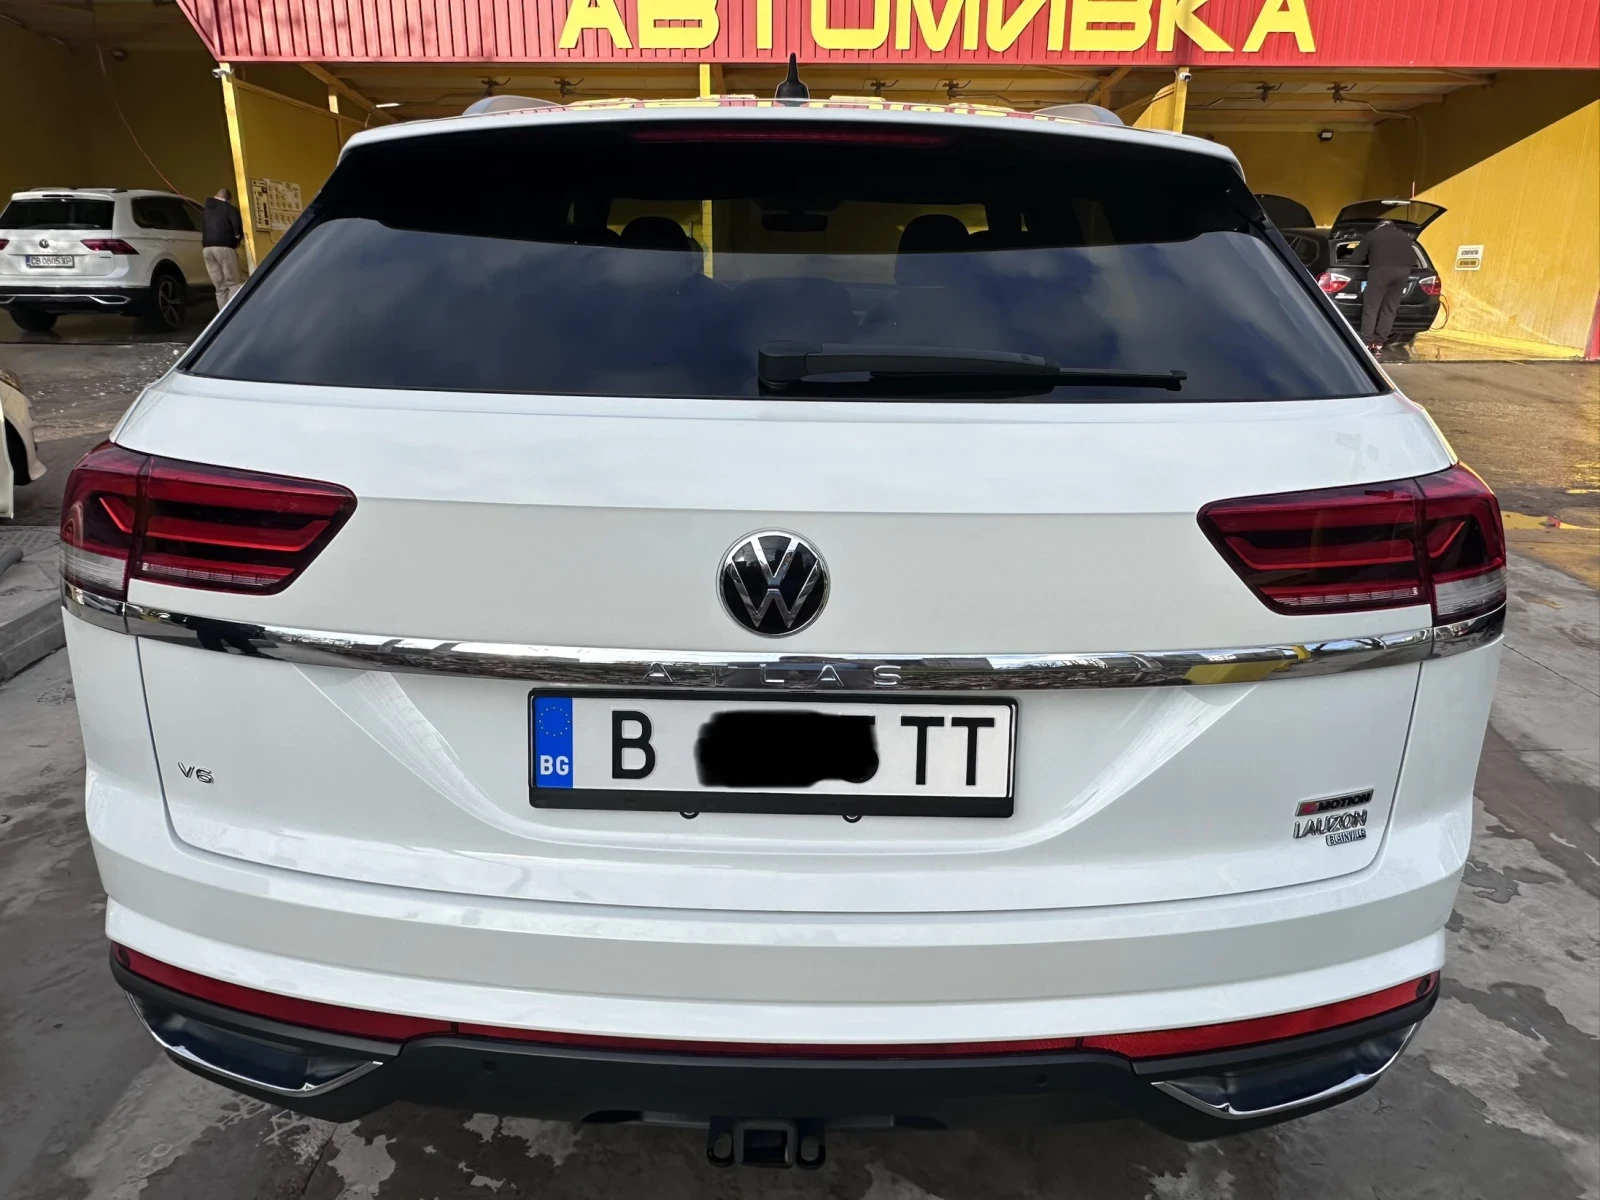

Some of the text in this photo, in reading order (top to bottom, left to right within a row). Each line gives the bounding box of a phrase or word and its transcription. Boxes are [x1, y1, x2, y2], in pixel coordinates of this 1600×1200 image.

[643, 661, 902, 688] ATLAS
[612, 710, 656, 780] B
[900, 715, 996, 786] TT
[177, 761, 215, 785] V6
[540, 755, 570, 776] BG
